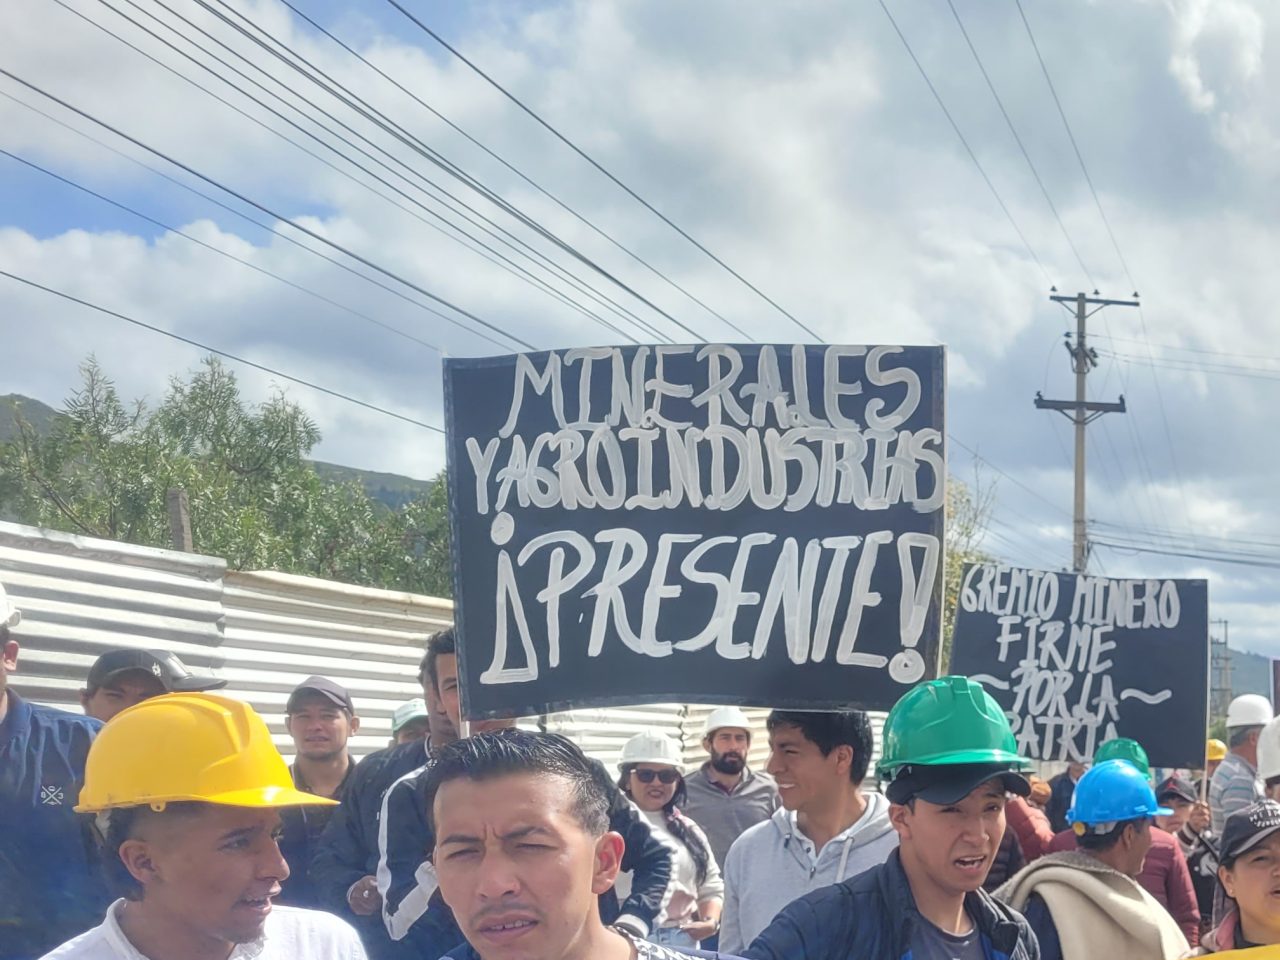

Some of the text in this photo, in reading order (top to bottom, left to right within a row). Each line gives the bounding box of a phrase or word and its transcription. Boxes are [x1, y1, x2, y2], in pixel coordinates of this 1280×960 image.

[499, 344, 923, 438] MINERALES
[960, 563, 1181, 630] GREMIO MINERO
[995, 615, 1118, 675] FIRME
[1010, 666, 1121, 726] POR LA
